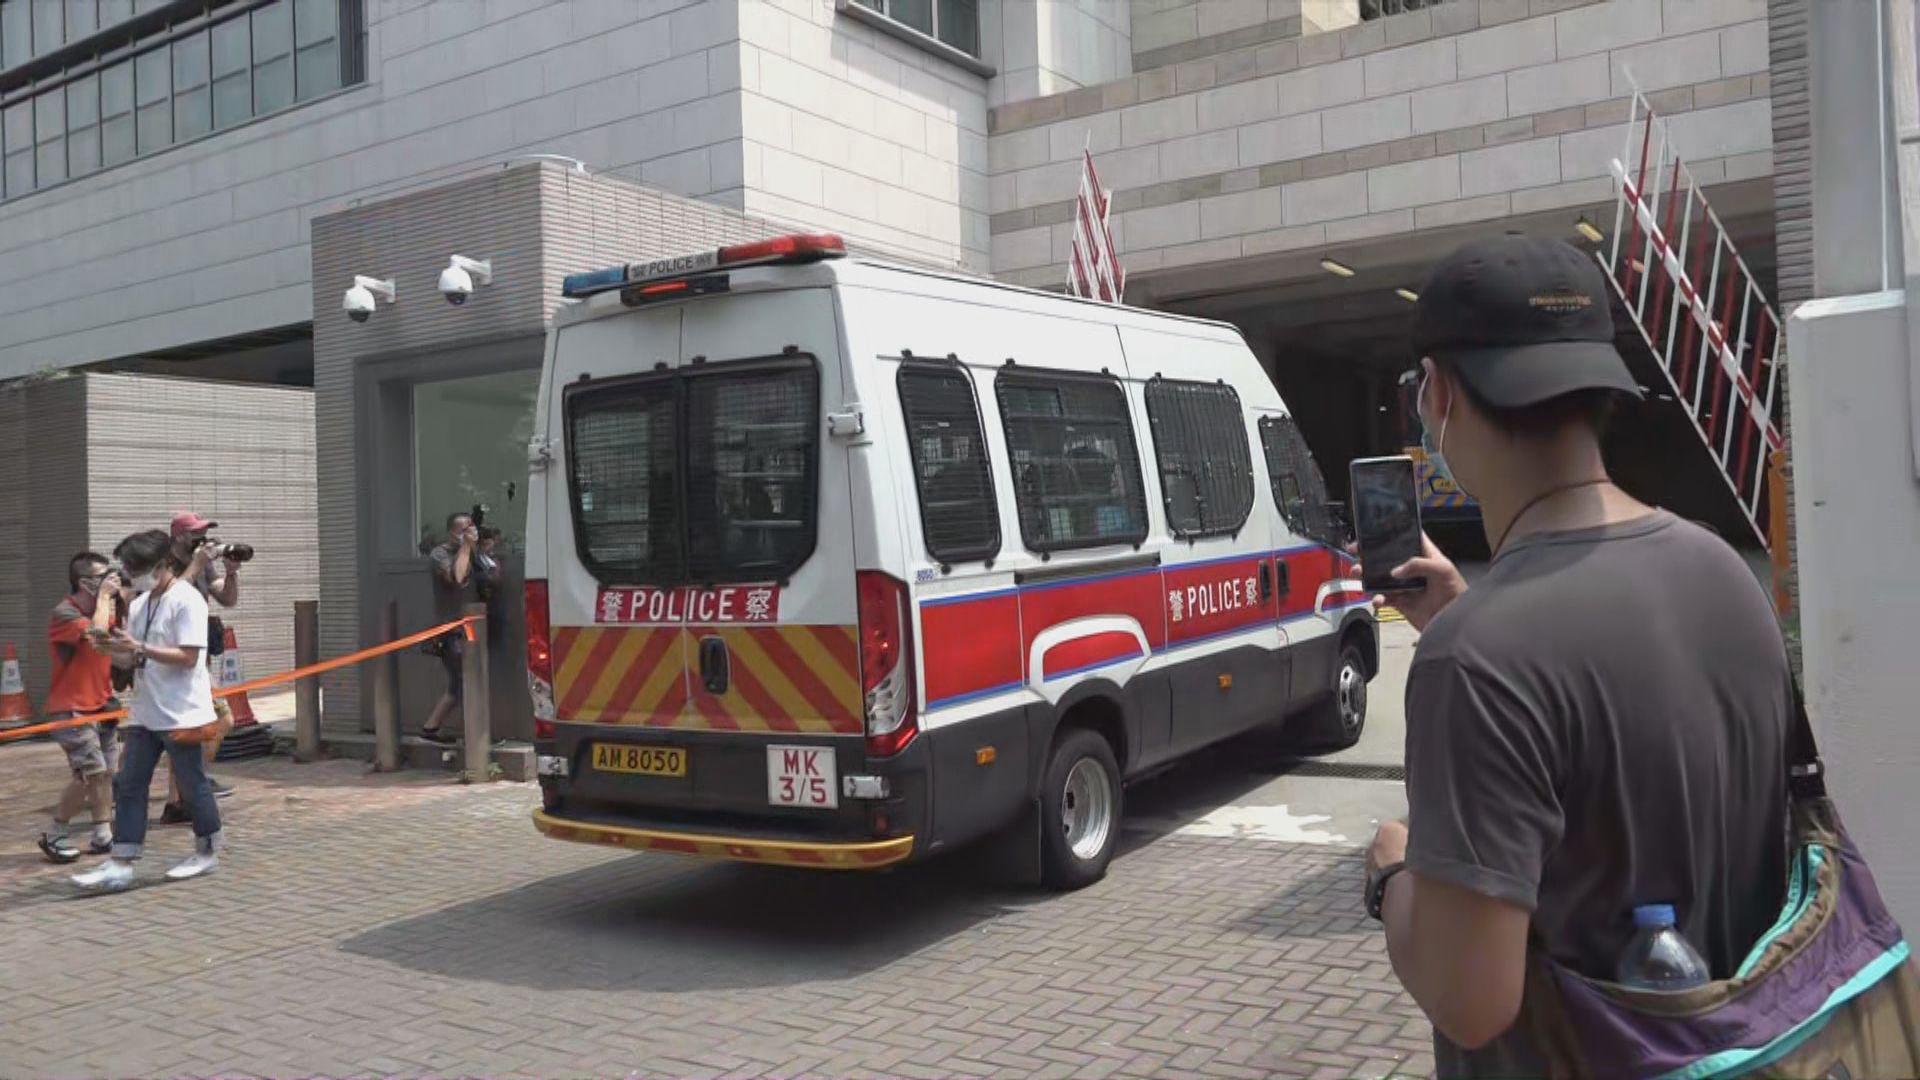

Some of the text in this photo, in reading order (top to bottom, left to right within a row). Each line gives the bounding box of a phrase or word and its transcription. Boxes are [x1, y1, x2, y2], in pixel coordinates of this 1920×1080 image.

[649, 257, 693, 274] POLICE
[603, 588, 772, 621] 警 POLICE 察
[1187, 578, 1241, 618] POLICE
[598, 746, 680, 772] AM 8050
[784, 749, 819, 775] MK
[779, 776, 826, 803] 3/5
